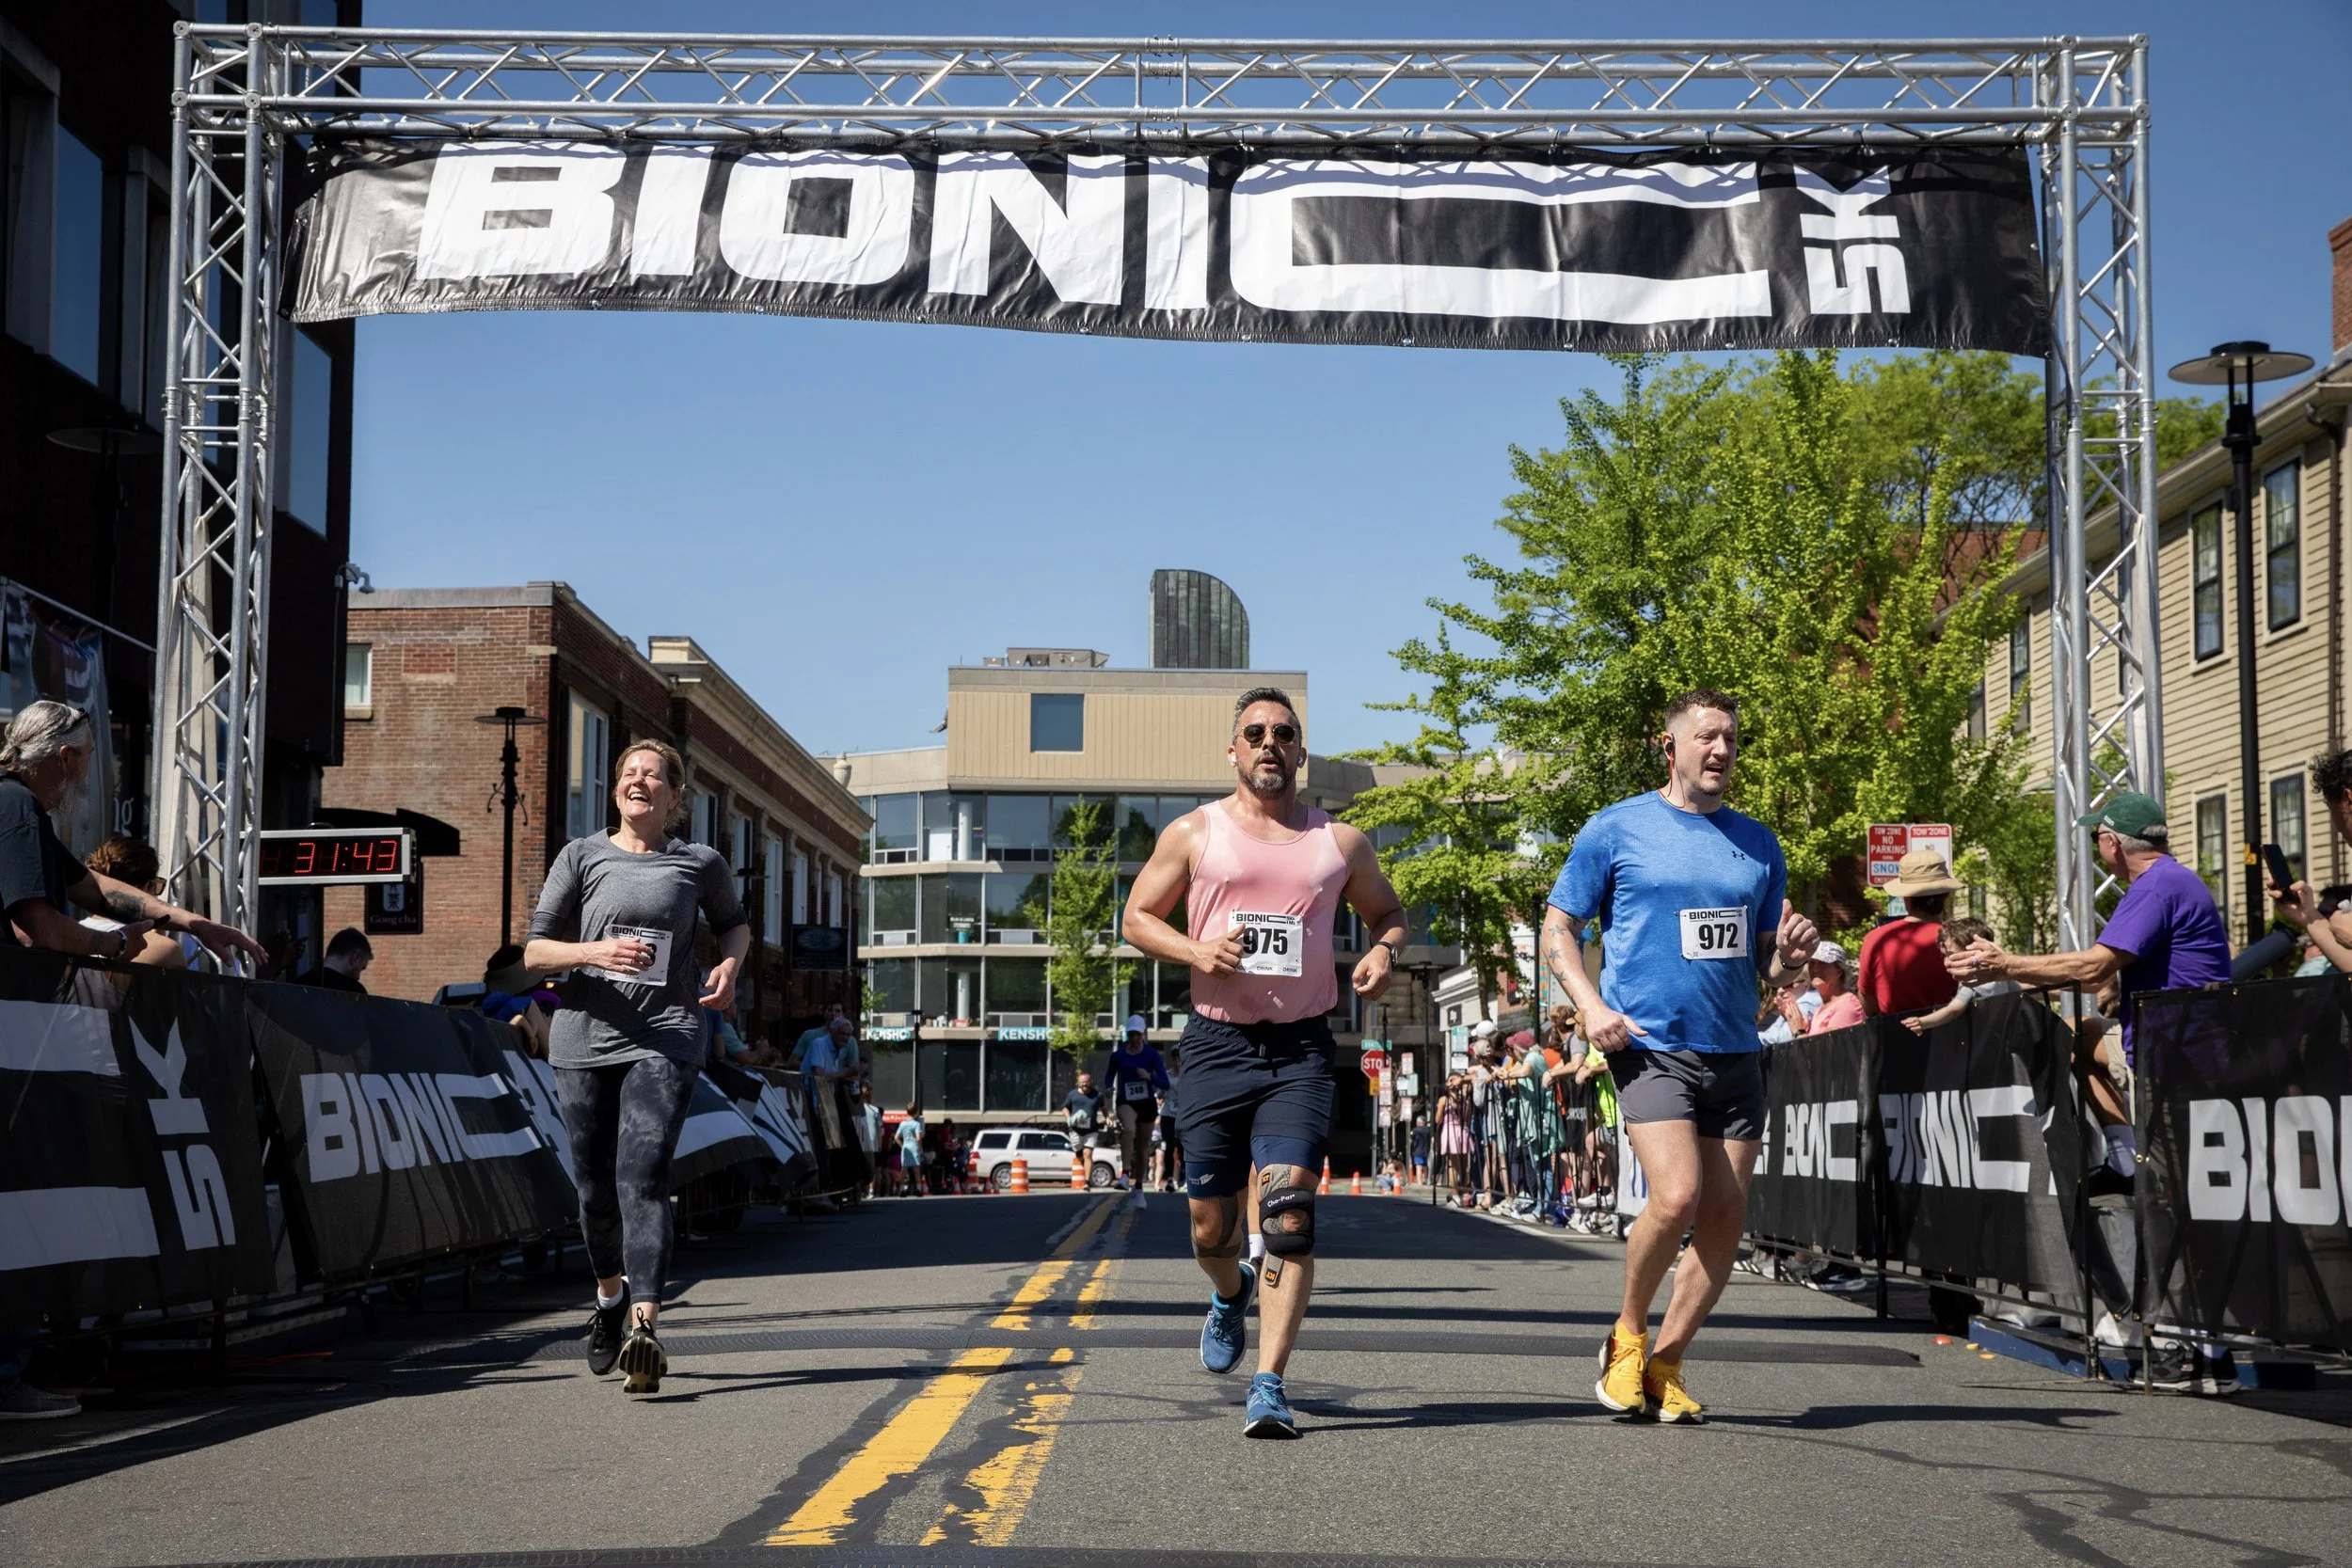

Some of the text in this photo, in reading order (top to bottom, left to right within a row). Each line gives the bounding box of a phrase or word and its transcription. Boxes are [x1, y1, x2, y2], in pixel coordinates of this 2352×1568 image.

[417, 143, 1773, 325] BIONIC
[1794, 164, 1912, 314] 5K
[294, 840, 398, 873] 31:43
[1871, 846, 1906, 854] PARKING
[1236, 913, 1286, 924] BIONIC
[1689, 910, 1736, 920] BIONIC
[612, 927, 659, 940] BIONIC
[1243, 927, 1288, 955] 975
[1698, 923, 1739, 950] 972
[128, 1015, 236, 1251] 5K
[300, 1072, 542, 1183] BIONIC
[2187, 1095, 2352, 1228] BIO
